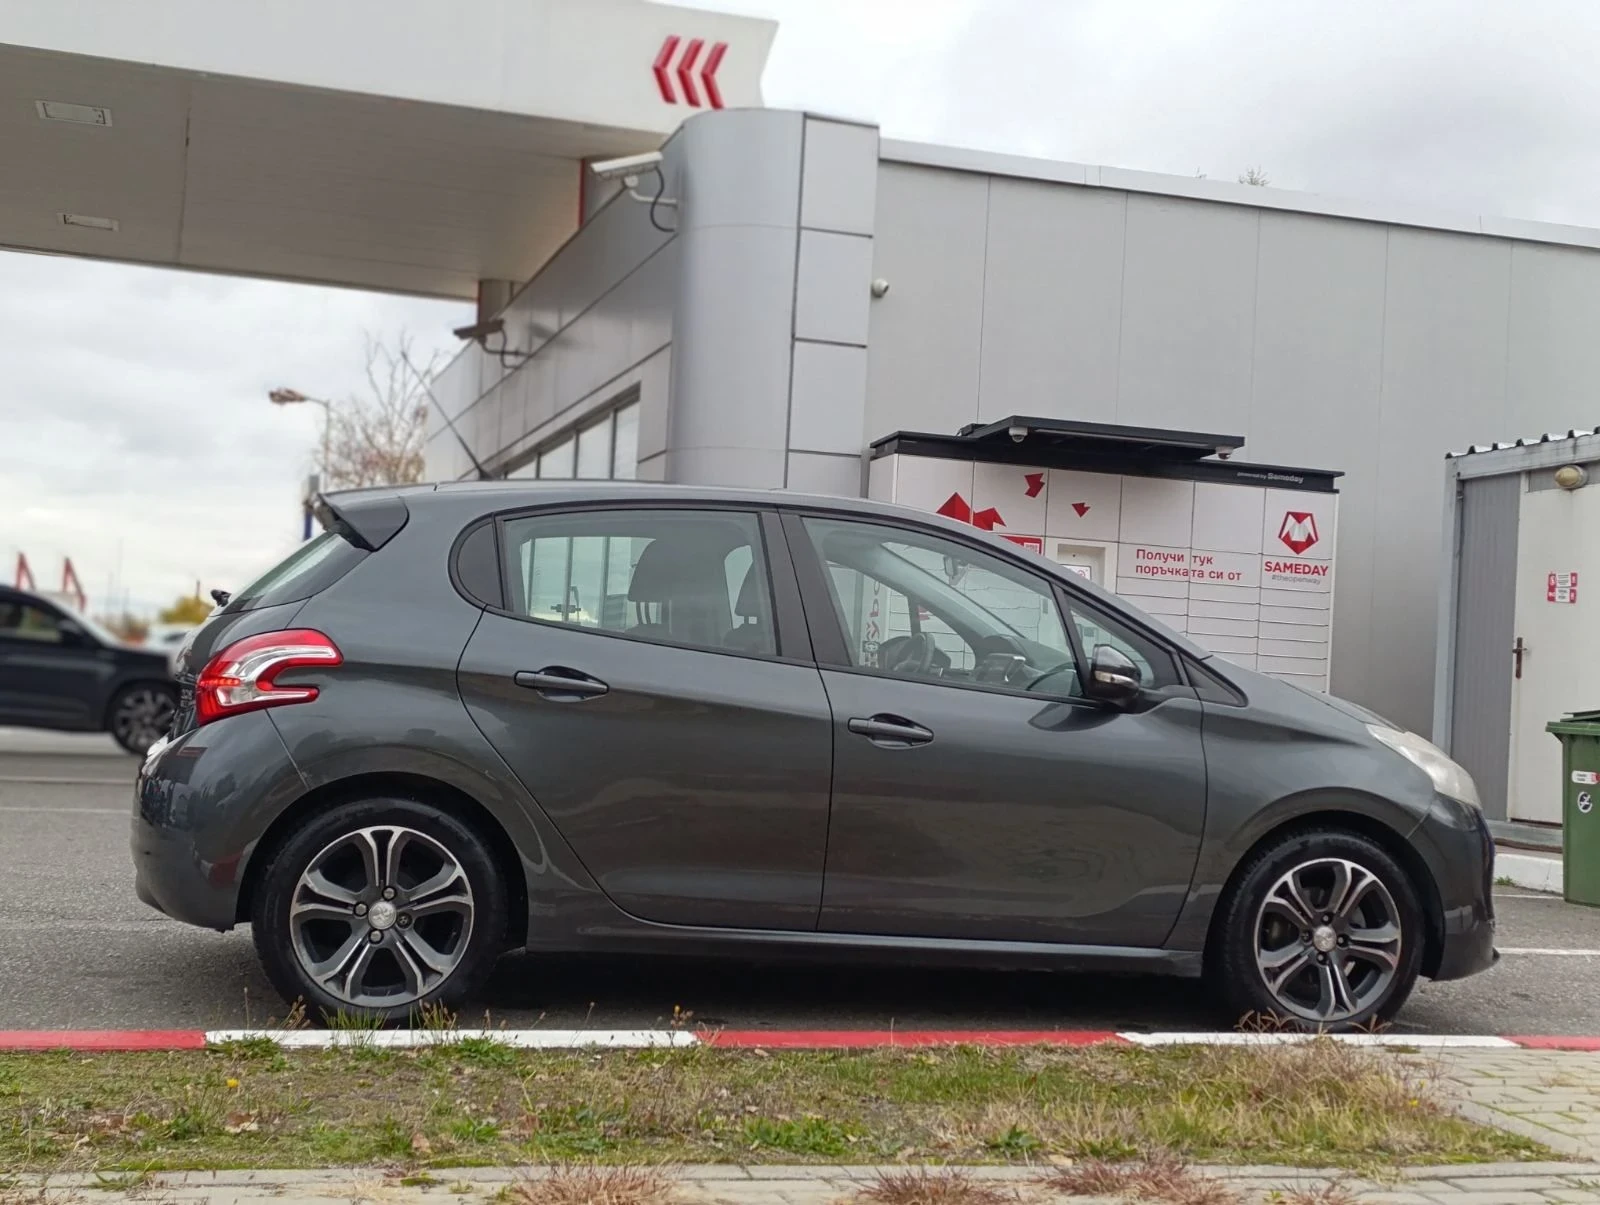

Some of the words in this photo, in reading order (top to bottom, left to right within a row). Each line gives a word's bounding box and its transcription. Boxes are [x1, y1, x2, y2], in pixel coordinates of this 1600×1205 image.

[1267, 472, 1304, 484] Sameday
[1136, 549, 1184, 563] Получи
[1192, 555, 1213, 566] тук
[1264, 561, 1329, 576] SAMEDAY
[1209, 570, 1223, 579] си
[1228, 572, 1242, 581] от
